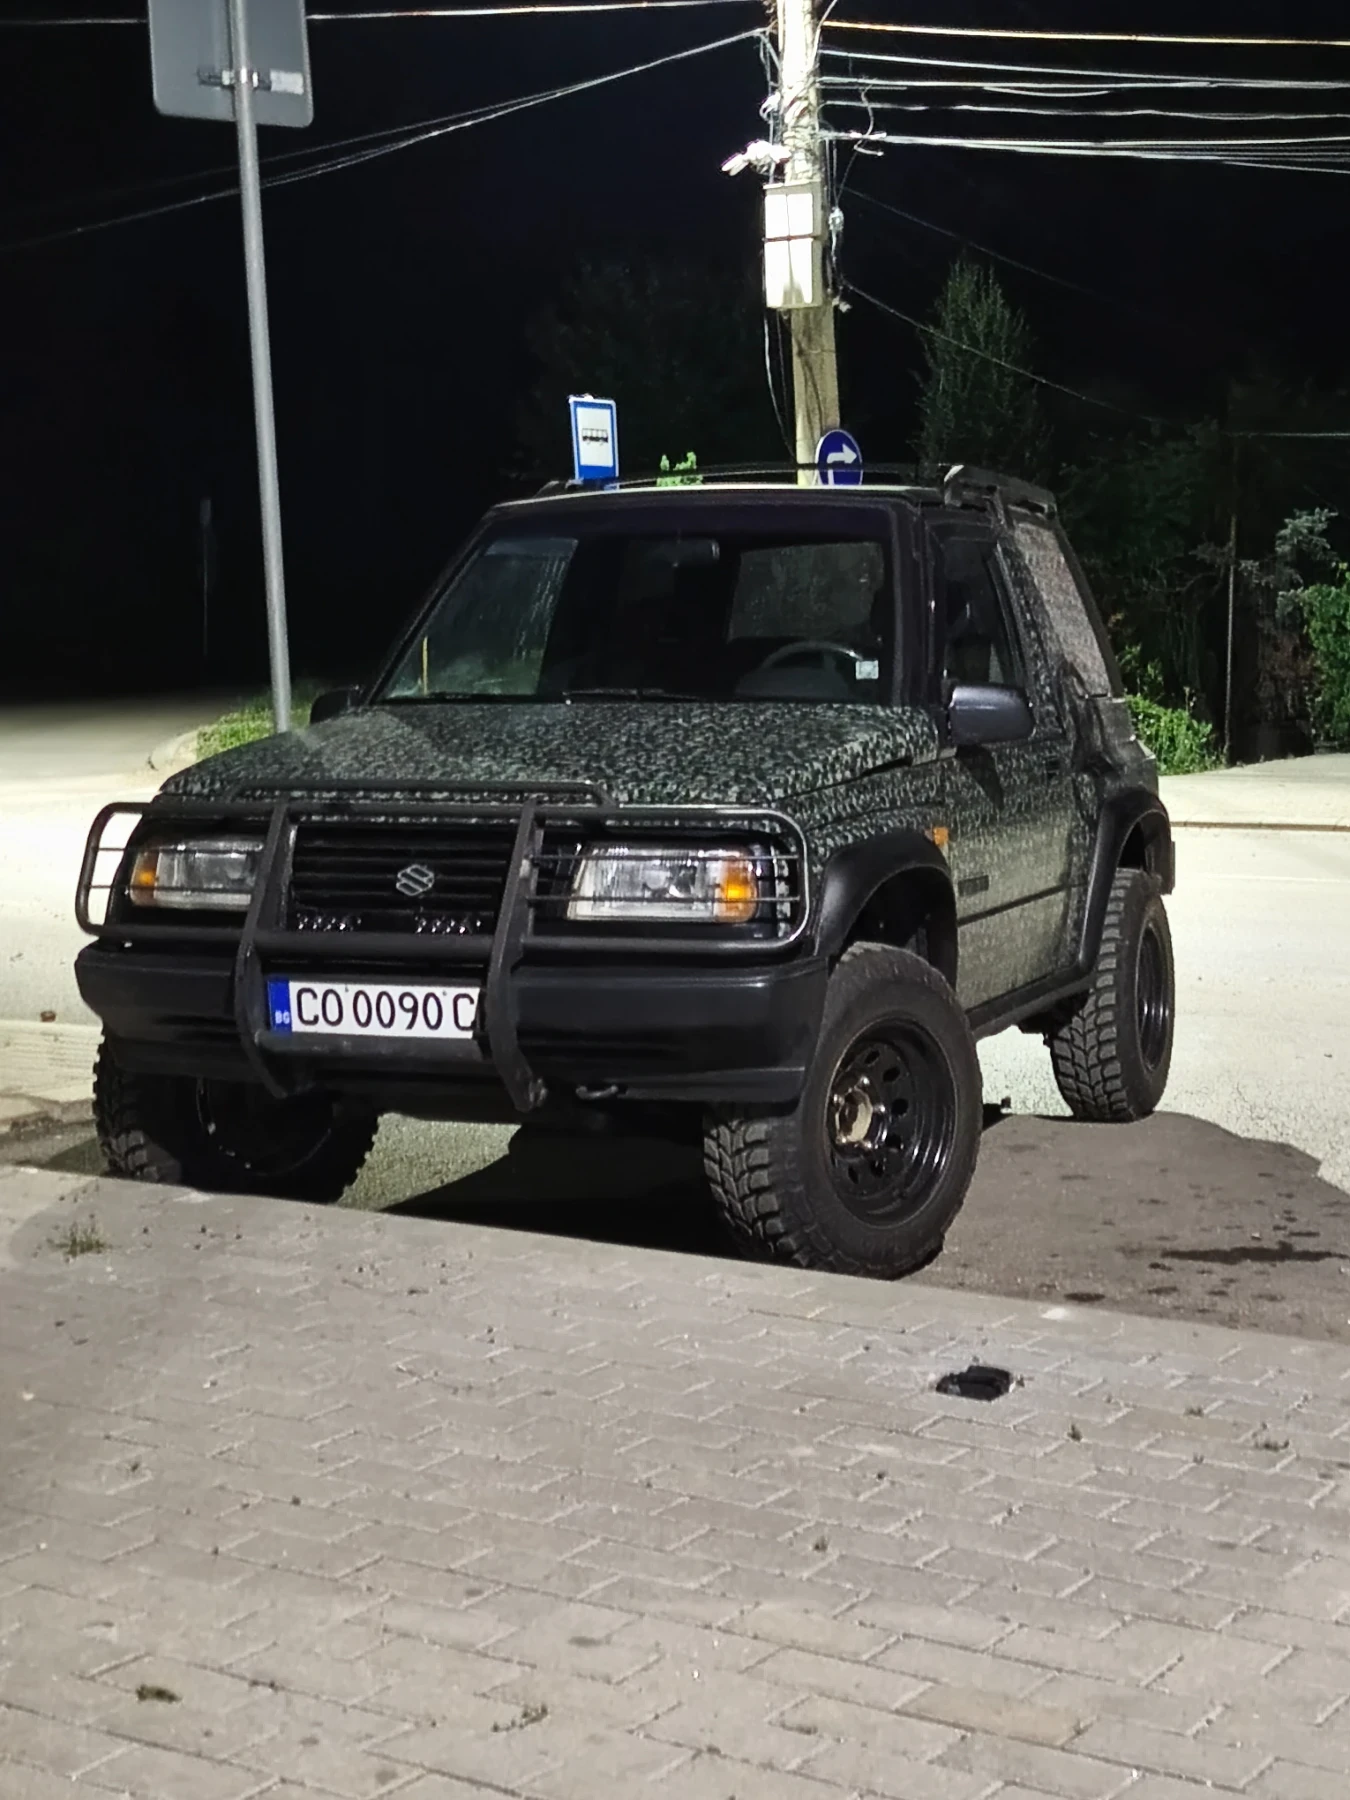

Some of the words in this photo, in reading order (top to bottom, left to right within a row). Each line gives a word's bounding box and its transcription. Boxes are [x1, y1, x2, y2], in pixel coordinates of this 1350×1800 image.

[275, 1010, 290, 1025] BG
[296, 987, 344, 1027] CO
[352, 989, 443, 1031] 0090
[452, 992, 476, 1032] C
